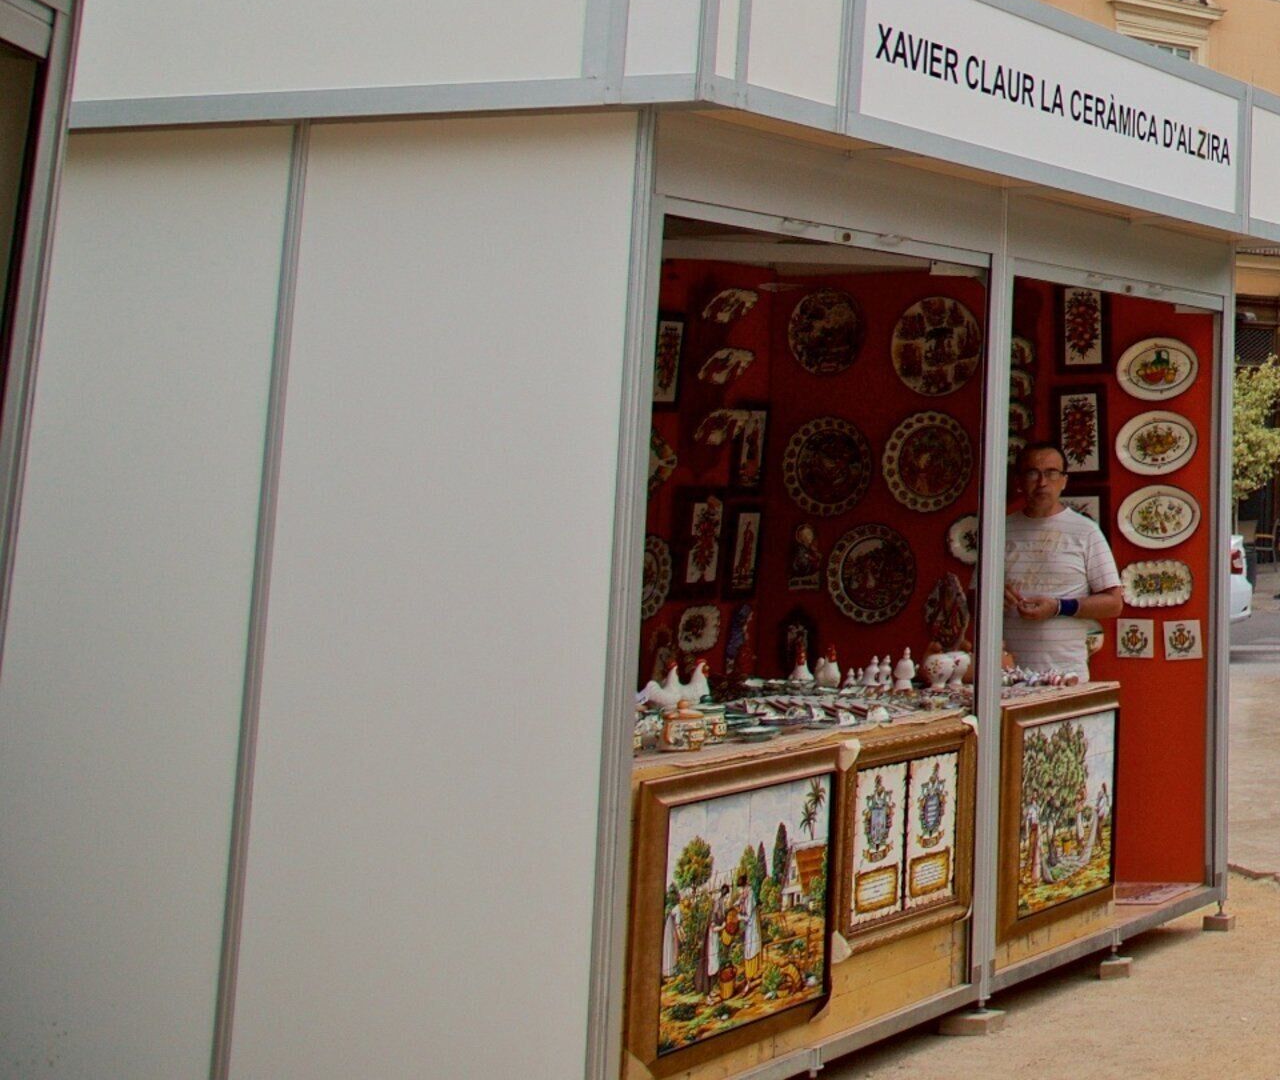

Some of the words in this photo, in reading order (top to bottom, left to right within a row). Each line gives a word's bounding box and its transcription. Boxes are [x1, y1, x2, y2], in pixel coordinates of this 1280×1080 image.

[875, 23, 958, 84] XAVIER
[965, 55, 1034, 107] CLAUR
[1040, 79, 1064, 117] LA
[1070, 90, 1158, 145] CERÀMICA
[1163, 119, 1231, 166] D'ALZIRA
